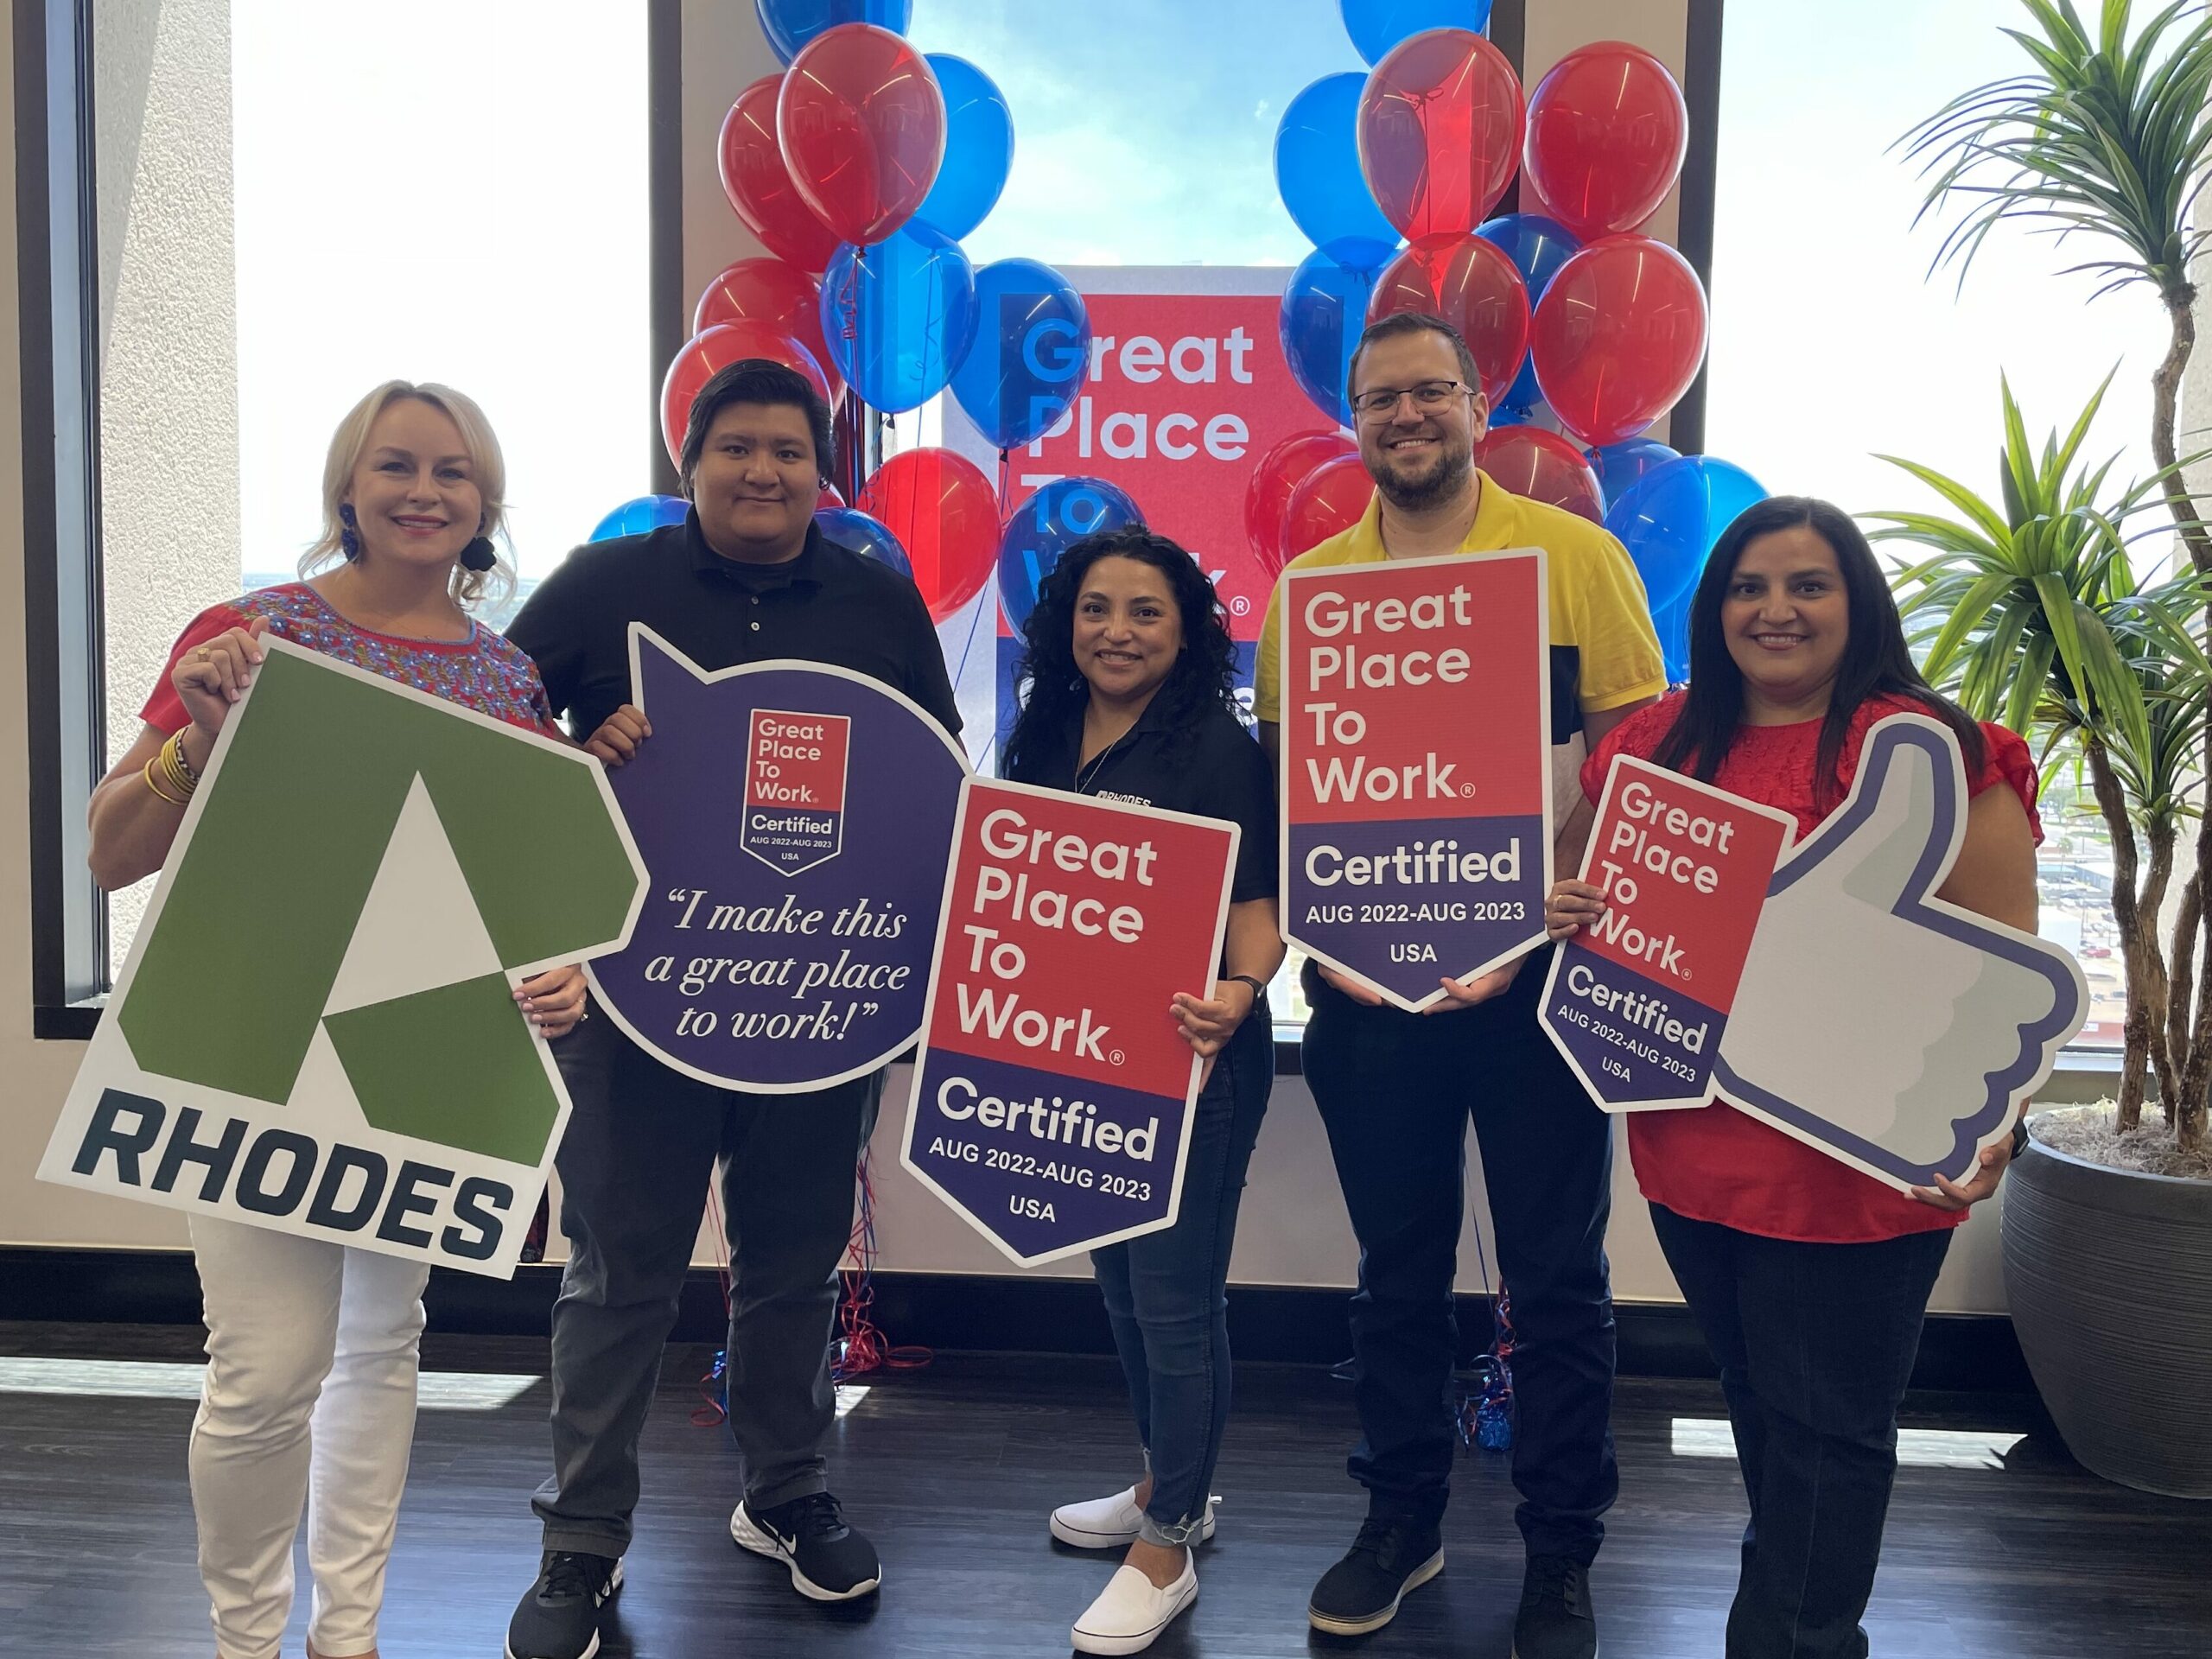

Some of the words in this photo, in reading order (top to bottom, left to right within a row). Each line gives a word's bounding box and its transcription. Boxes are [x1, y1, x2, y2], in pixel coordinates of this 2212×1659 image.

[1022, 317, 1254, 385] Great
[1028, 395, 1249, 461] Place
[1020, 474, 1106, 534] To
[1305, 584, 1471, 638] Great
[1310, 645, 1471, 691] Place
[759, 719, 823, 741] Great
[1305, 702, 1366, 746] To
[756, 760, 780, 779] To
[759, 740, 821, 760] Place
[752, 814, 833, 835] Certified
[1621, 782, 1734, 855] Great
[980, 809, 1157, 887] Great
[1305, 837, 1520, 887] Certified
[1609, 820, 1718, 893] Place
[974, 866, 1144, 943] Place
[1601, 860, 1637, 905] To
[707, 894, 823, 934] make
[831, 898, 907, 938] this
[1306, 906, 1353, 923] AUG
[1474, 902, 1525, 921] 2023
[645, 955, 675, 982] a
[678, 955, 797, 996] great
[791, 950, 911, 999] place
[963, 925, 1026, 979] To
[1390, 944, 1437, 963] USA
[676, 1007, 717, 1037] to
[1567, 965, 1708, 1054] Certified
[1558, 1005, 1588, 1027] AUG
[1662, 1056, 1696, 1082] 2023
[1602, 1057, 1631, 1083] USA
[937, 1077, 1159, 1162] Certified
[71, 1087, 514, 1261] RHODES
[929, 1137, 978, 1163] AUG
[1099, 1174, 1151, 1201] 2023
[1009, 1195, 1056, 1223] USA
